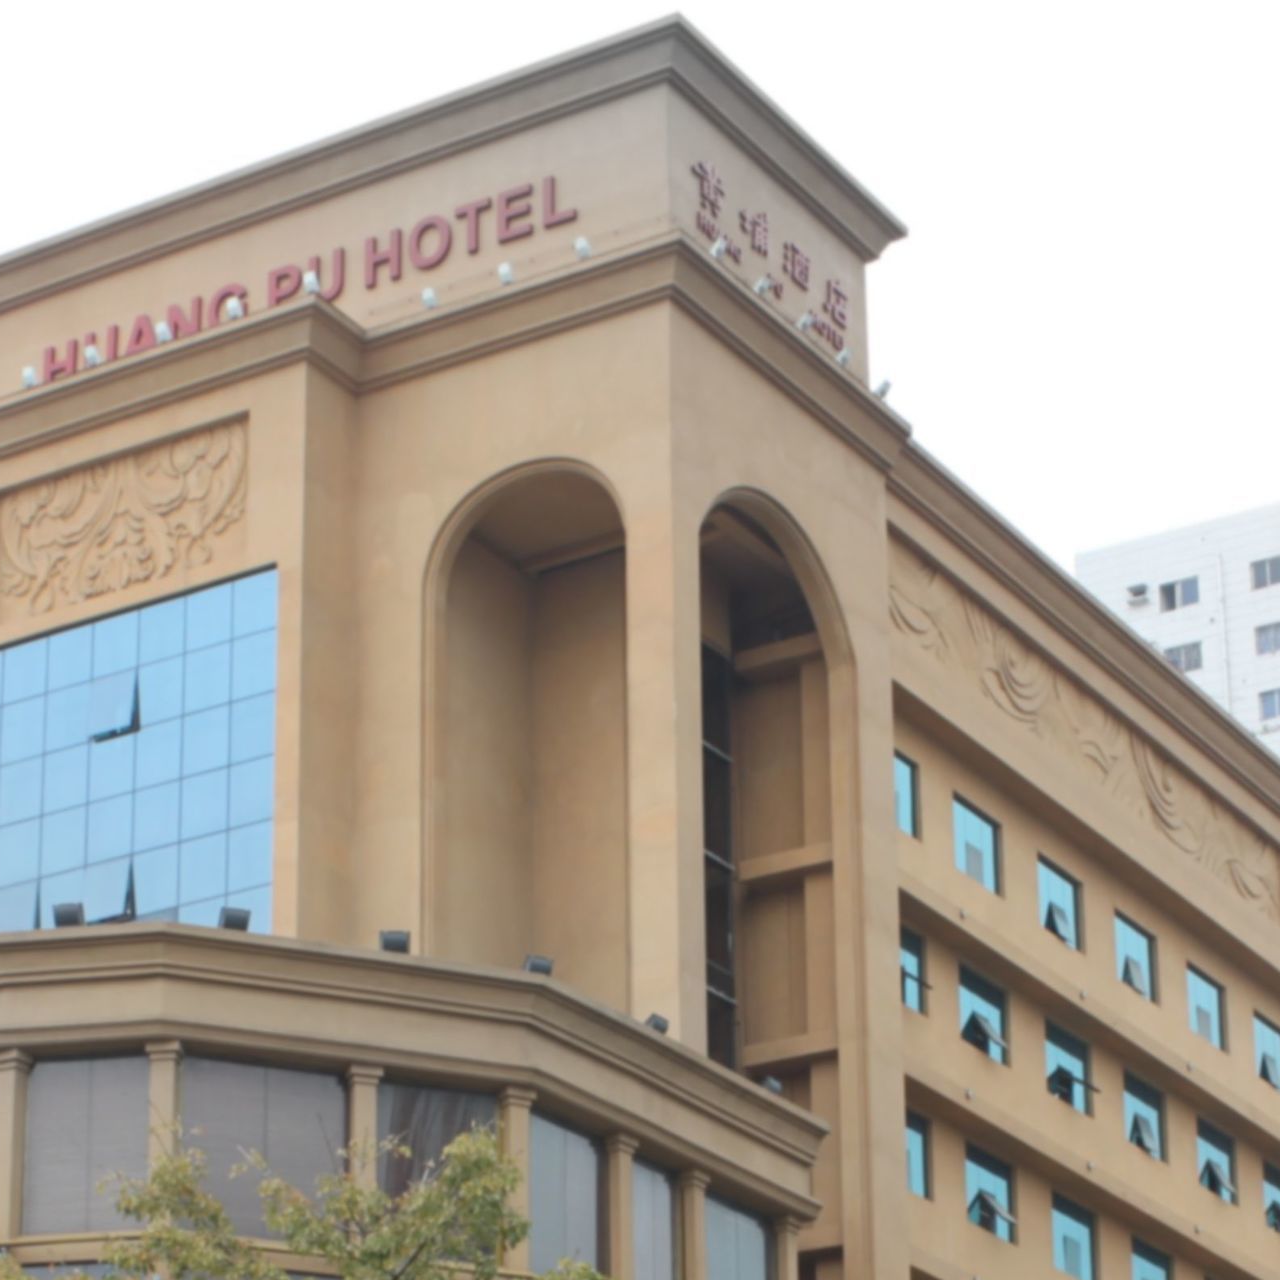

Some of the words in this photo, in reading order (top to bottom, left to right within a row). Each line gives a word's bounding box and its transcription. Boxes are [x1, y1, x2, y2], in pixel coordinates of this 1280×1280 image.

[42, 282, 248, 383] HUANG
[266, 247, 345, 307] PU
[363, 175, 578, 290] HOTEL
